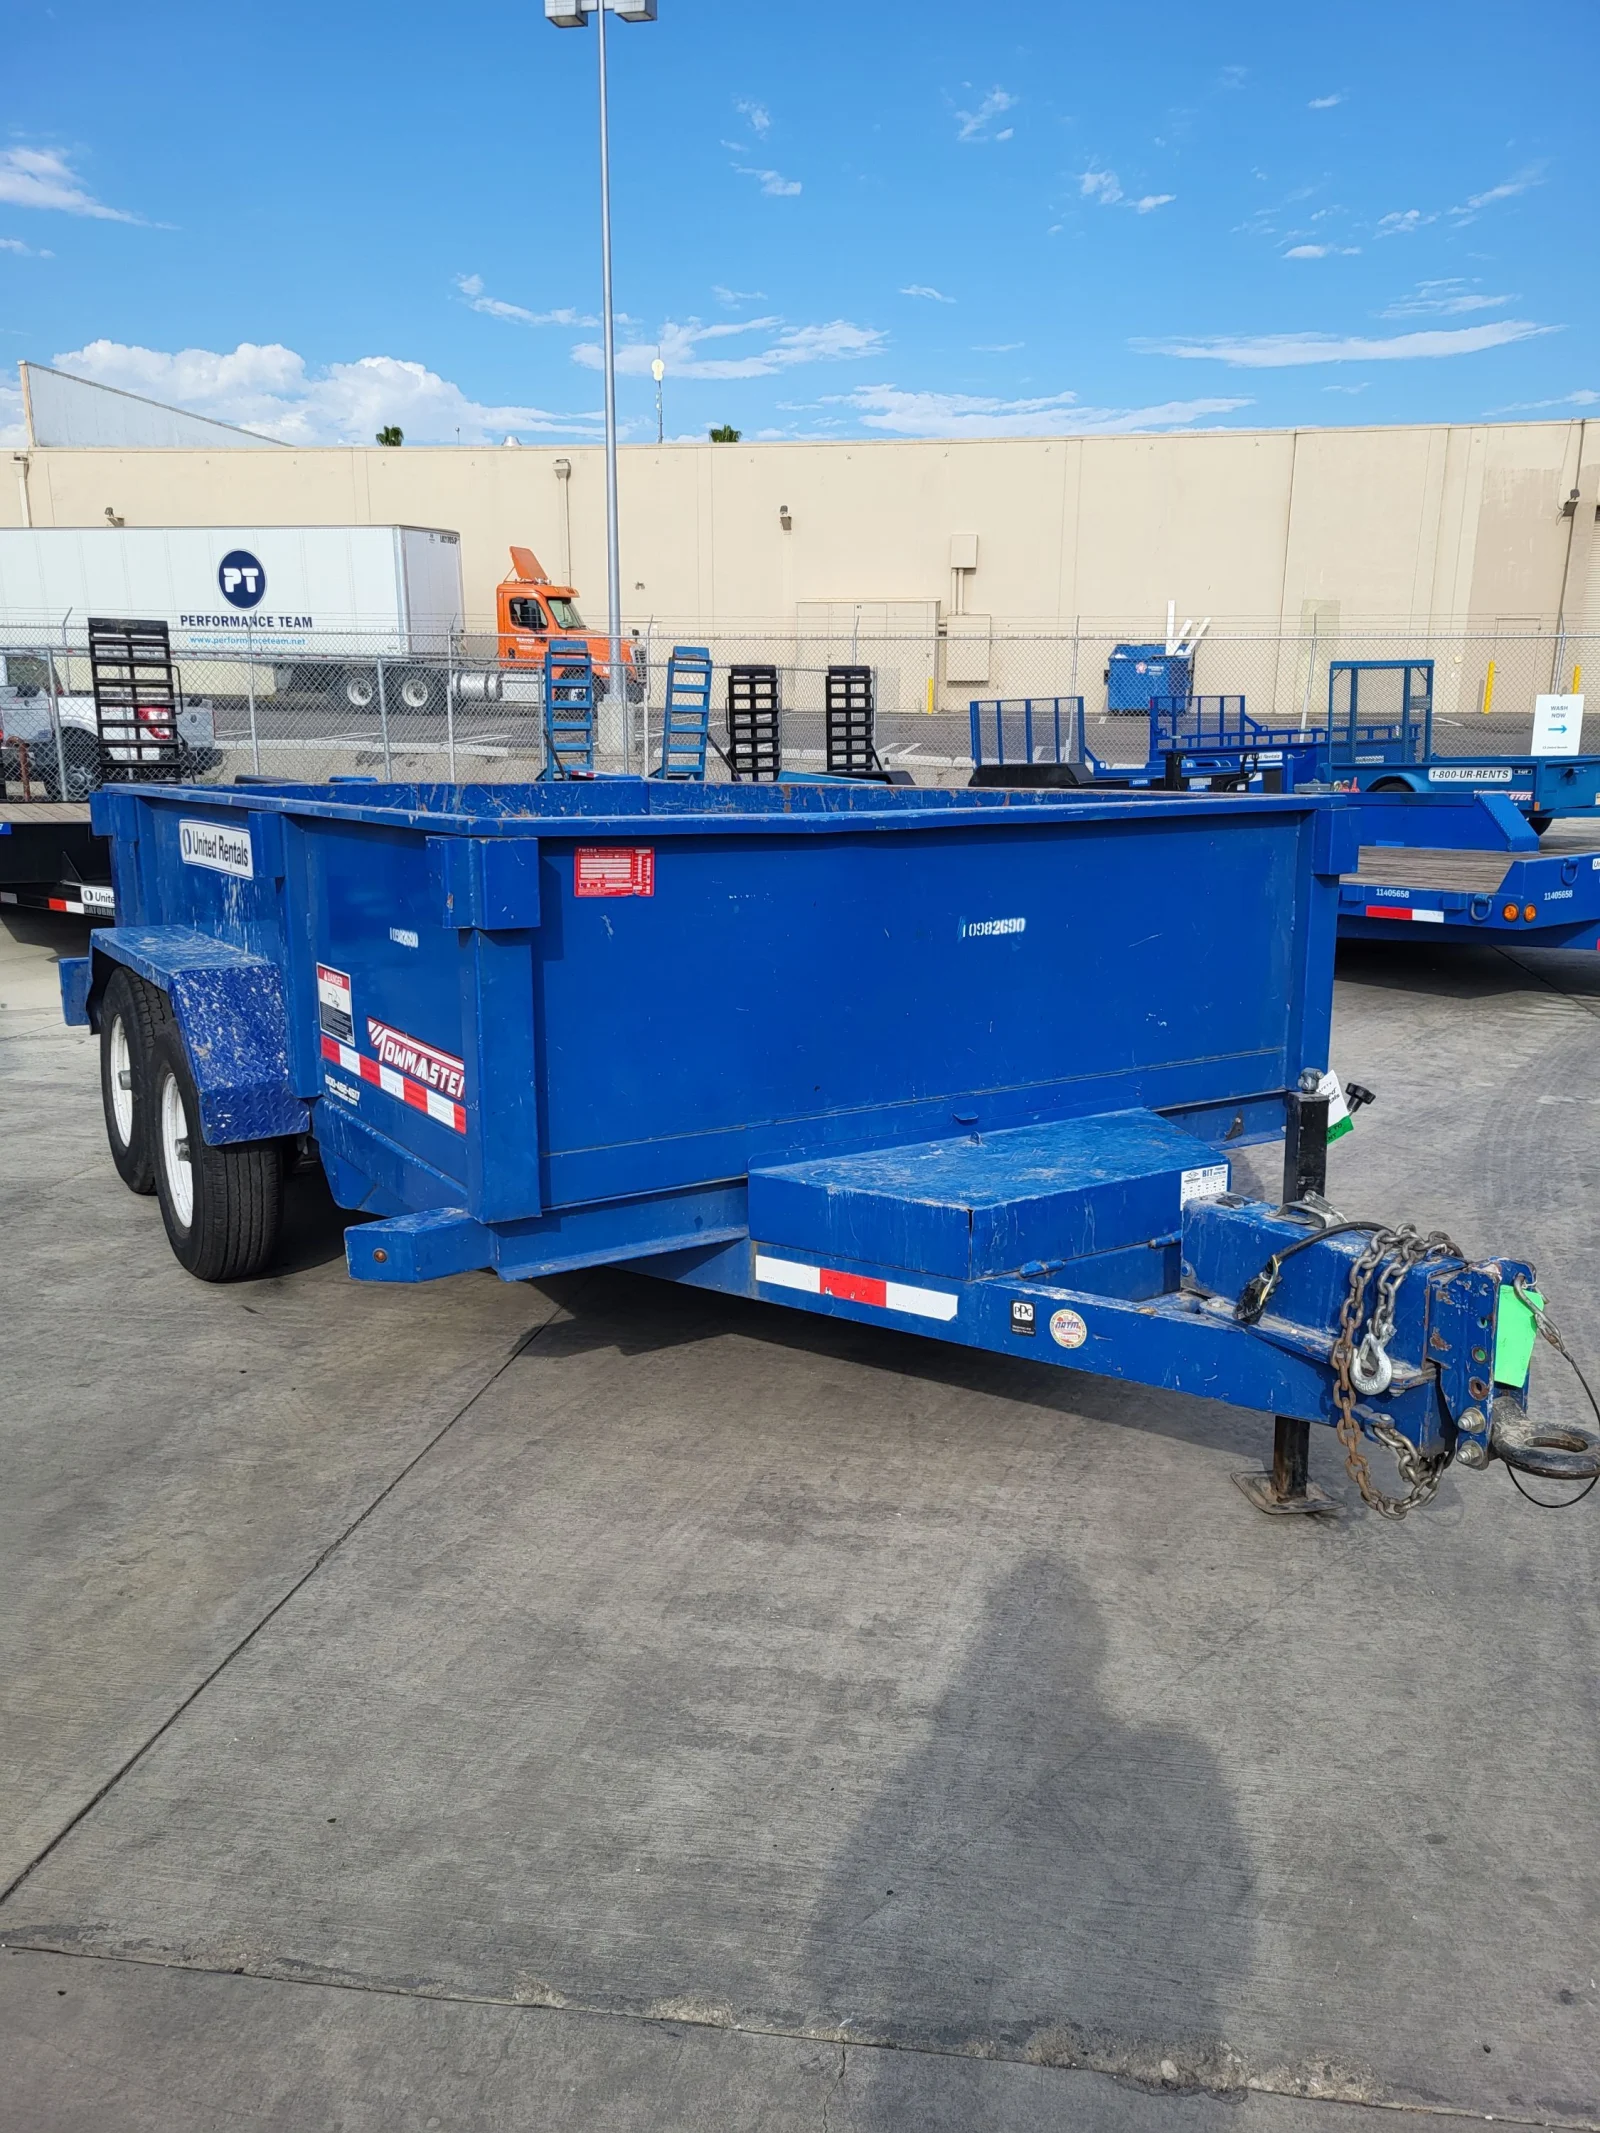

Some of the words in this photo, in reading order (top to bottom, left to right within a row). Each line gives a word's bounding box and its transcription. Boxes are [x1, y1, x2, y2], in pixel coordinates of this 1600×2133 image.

[223, 567, 259, 593] PT
[180, 615, 275, 628] PERFORMANCE
[278, 616, 313, 628] TEAM
[1431, 769, 1509, 779] 1-800-UR-RENTS
[192, 830, 217, 859] United
[218, 834, 249, 867] Rentals
[94, 891, 115, 904] Unite
[1376, 887, 1410, 899] 11405658
[1543, 889, 1574, 901] 11405658
[1202, 1168, 1213, 1178] BIT
[1014, 1304, 1032, 1318] PPG
